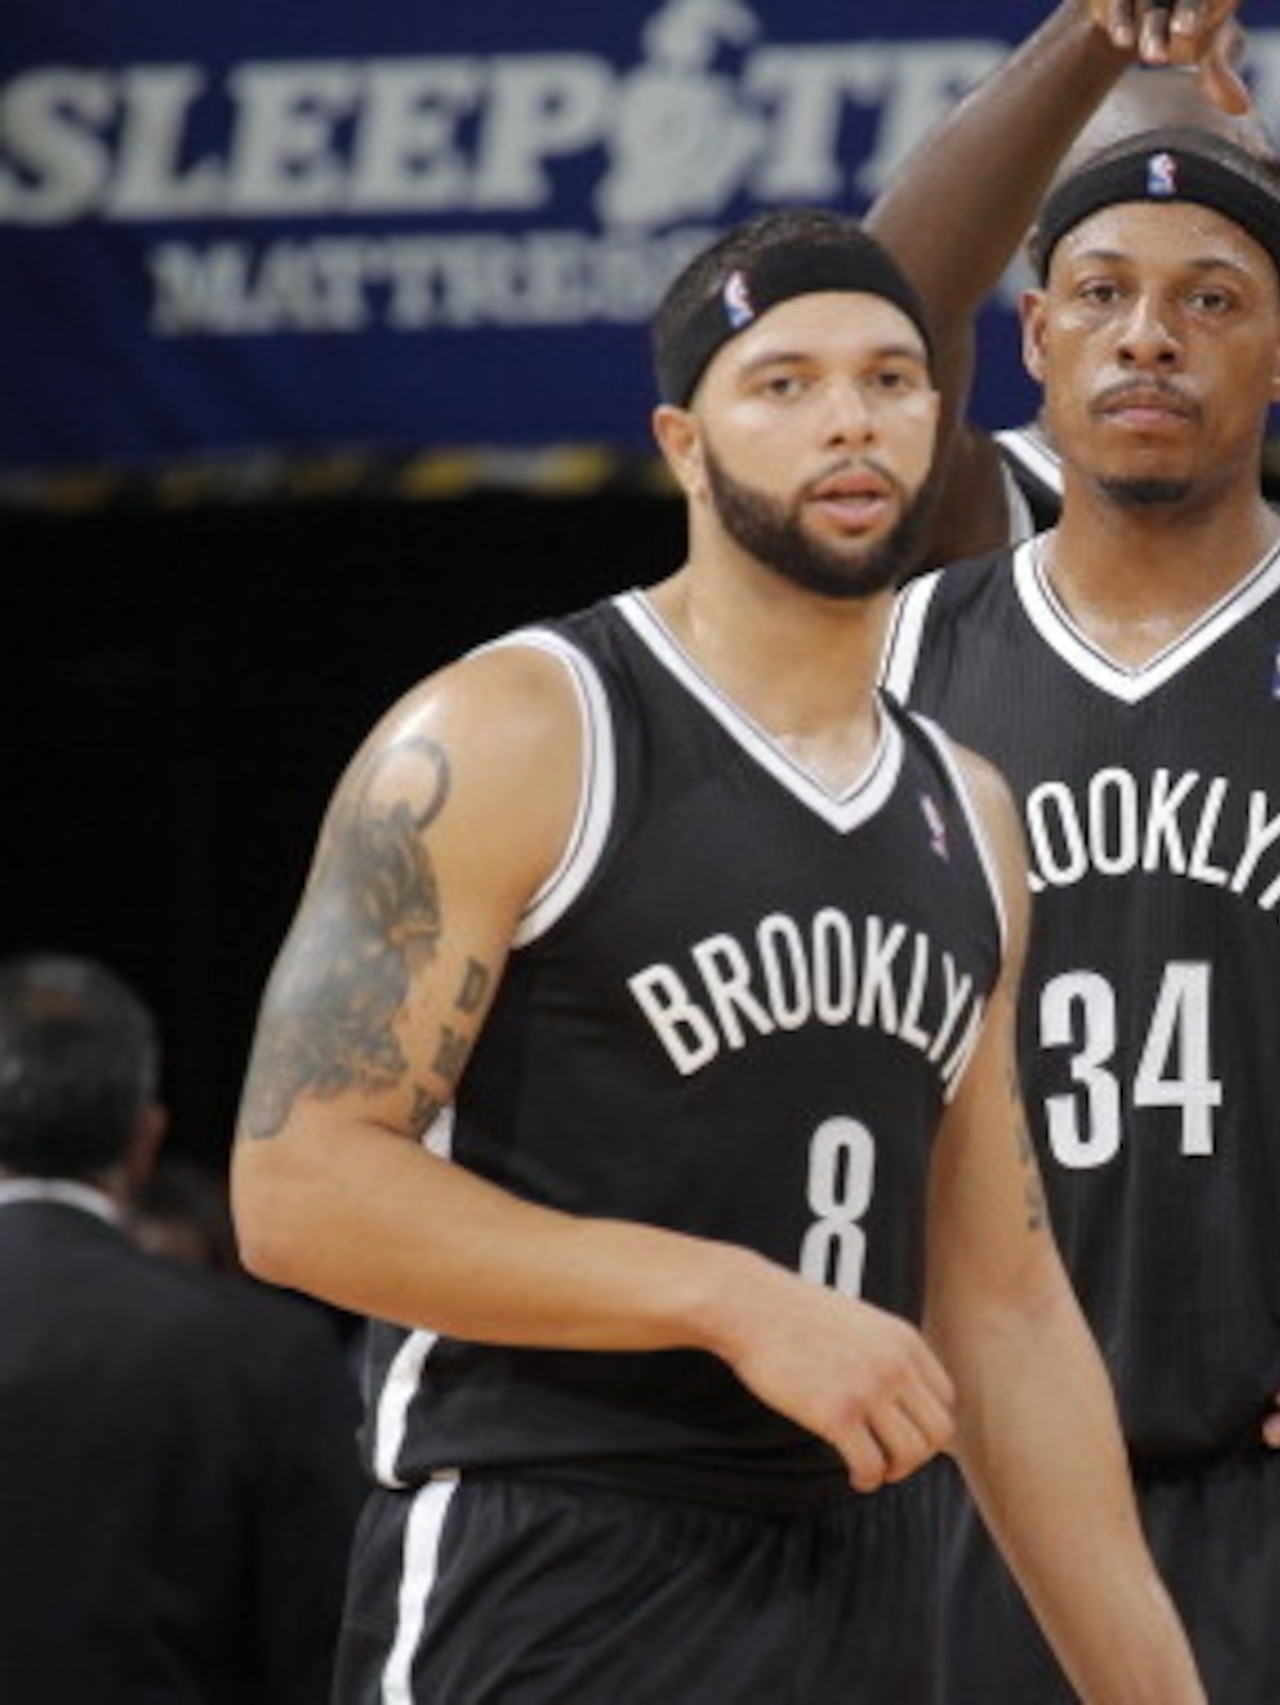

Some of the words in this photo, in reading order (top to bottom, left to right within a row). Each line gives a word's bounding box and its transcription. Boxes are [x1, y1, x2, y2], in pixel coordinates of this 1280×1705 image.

[0, 54, 612, 225] SLEEP
[1040, 961, 1222, 1169] 34
[800, 1116, 875, 1298] 8
